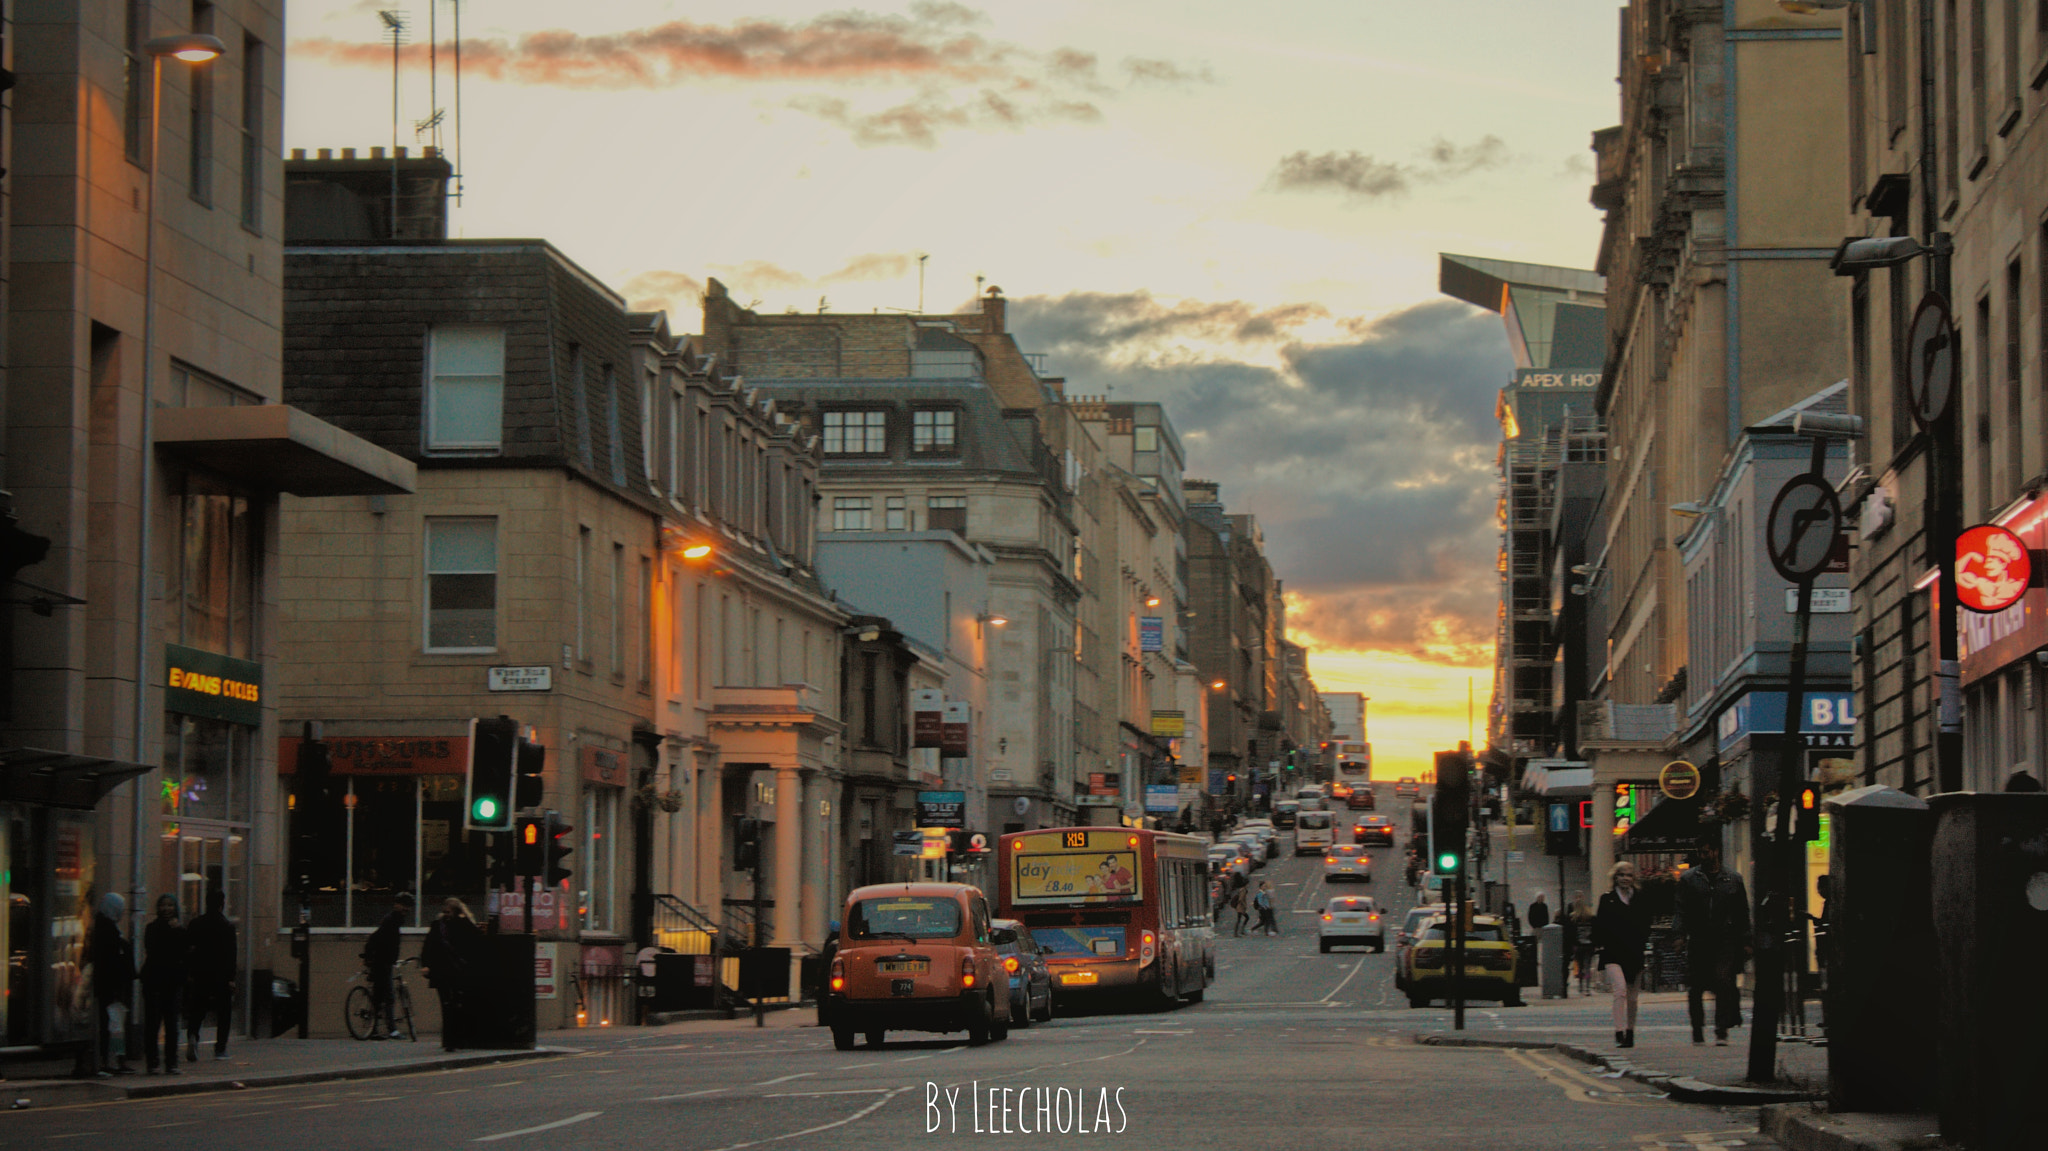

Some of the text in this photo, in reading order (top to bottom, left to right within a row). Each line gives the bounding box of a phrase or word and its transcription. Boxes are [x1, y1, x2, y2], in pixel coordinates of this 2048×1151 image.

[1521, 373, 1564, 387] APEX
[168, 667, 259, 702] EVANS CYCLES
[502, 677, 538, 685] STREET
[755, 782, 775, 805] THE
[922, 803, 961, 812] TO LET
[1066, 832, 1086, 848] X19
[1045, 880, 1074, 892] £8.40
